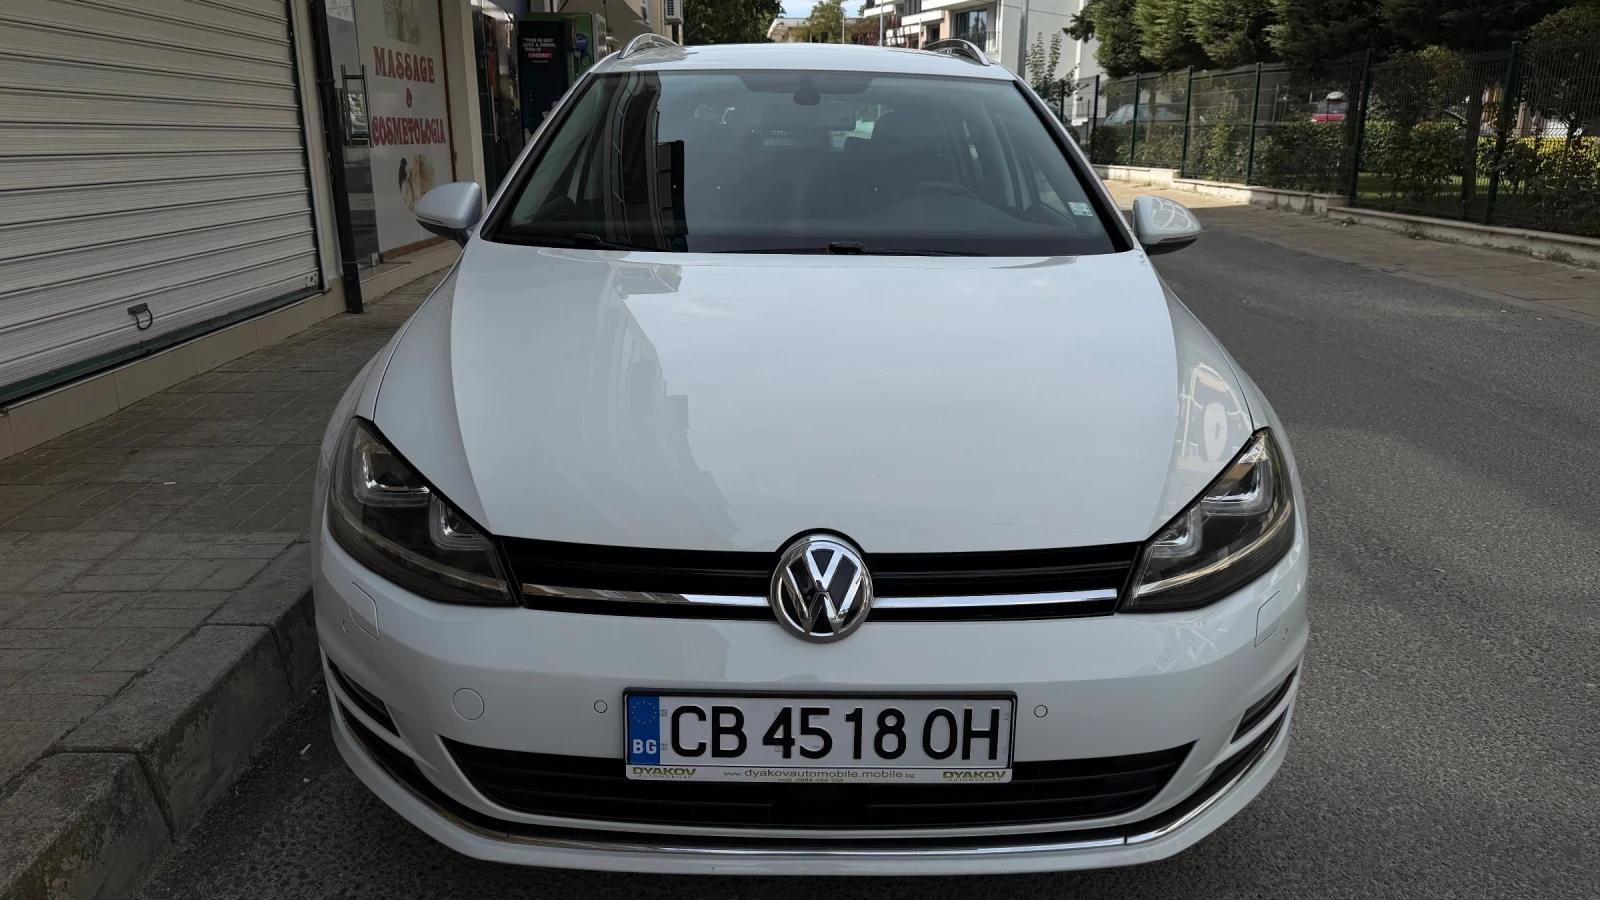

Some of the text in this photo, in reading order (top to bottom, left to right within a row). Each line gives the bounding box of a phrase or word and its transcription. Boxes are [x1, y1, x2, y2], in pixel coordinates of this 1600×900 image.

[373, 46, 435, 84] MASSAGE
[406, 88, 412, 108] &
[371, 116, 446, 146] COSMETOLOGIA
[671, 705, 1000, 760] CB 4518 OH
[632, 738, 657, 754] BG
[632, 766, 696, 776] DYAKOV
